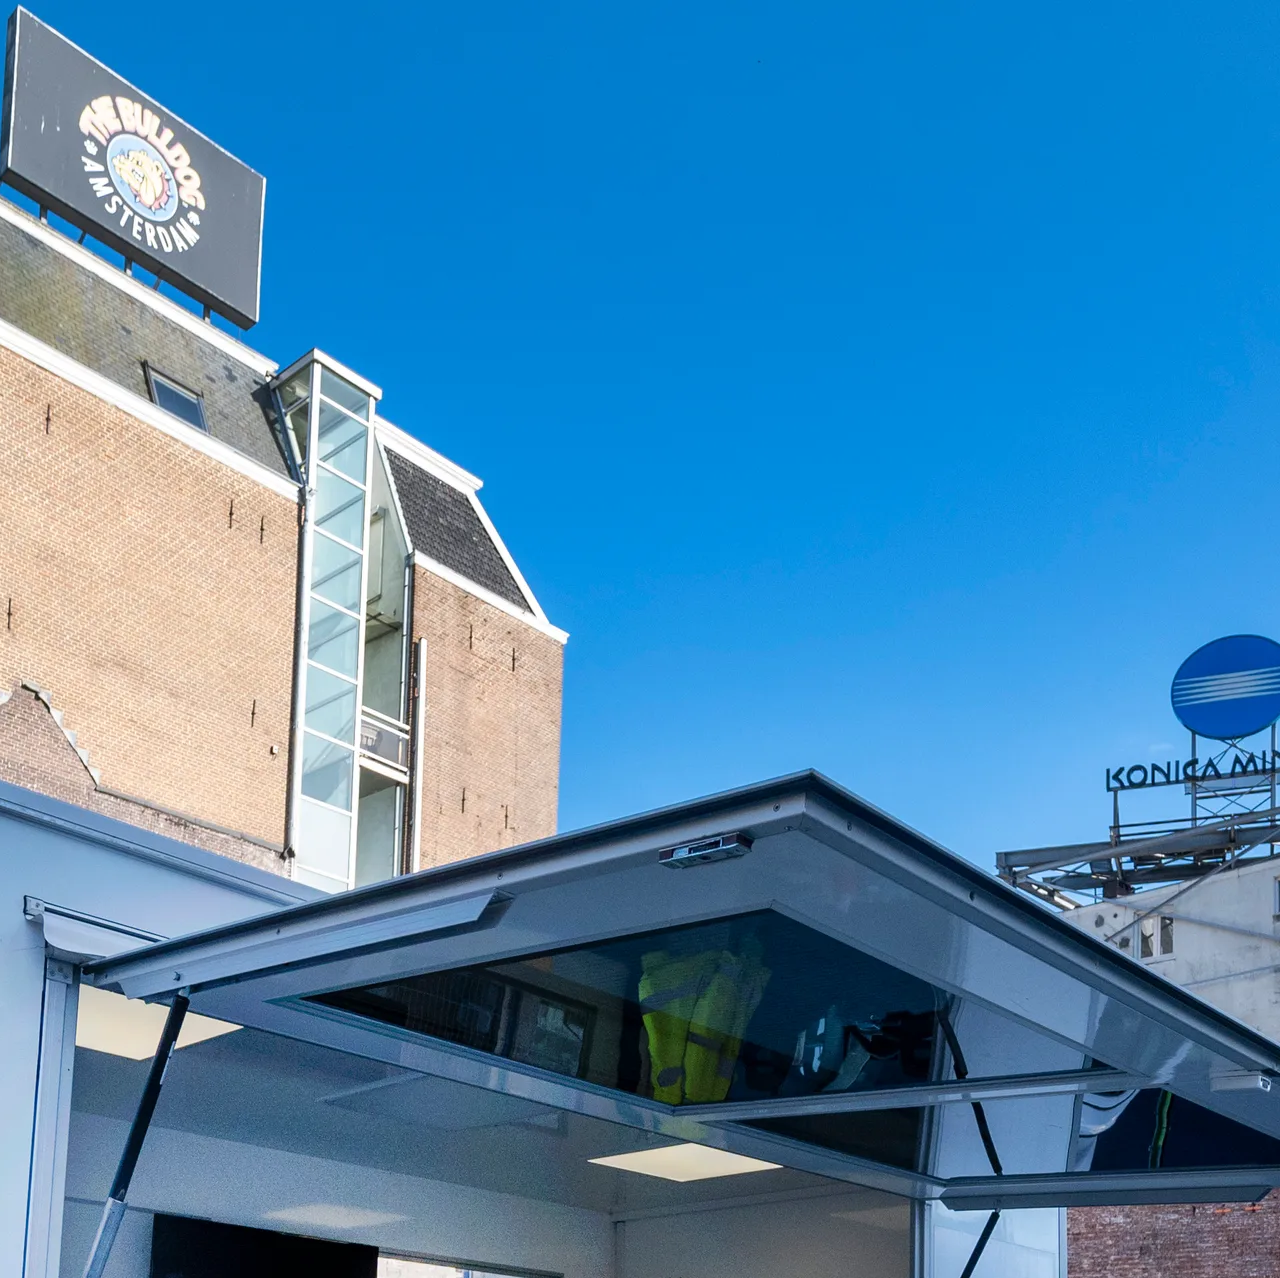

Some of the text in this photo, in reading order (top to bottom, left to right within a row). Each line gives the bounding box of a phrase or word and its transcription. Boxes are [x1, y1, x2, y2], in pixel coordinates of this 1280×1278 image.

[79, 96, 206, 211] THE BULLDOG
[81, 155, 200, 252] AMSTERDAM
[1106, 757, 1221, 792] KONICA
